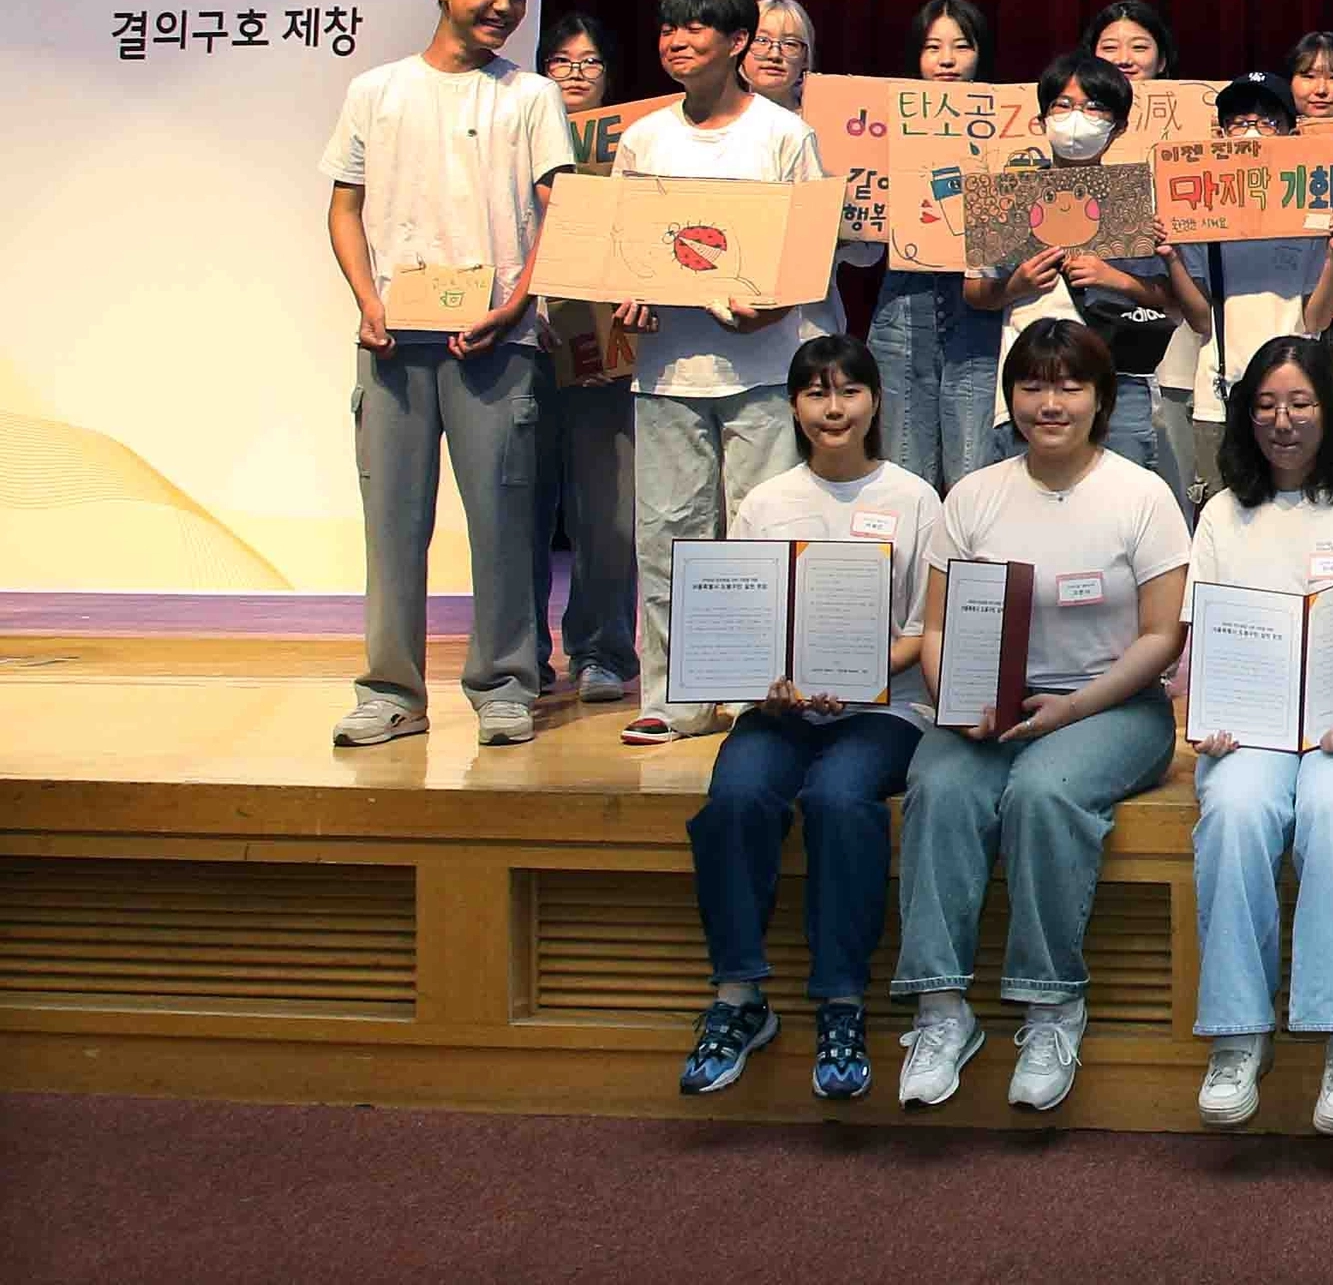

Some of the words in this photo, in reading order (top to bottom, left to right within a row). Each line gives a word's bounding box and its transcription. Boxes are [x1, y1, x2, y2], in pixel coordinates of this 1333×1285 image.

[111, 8, 270, 60] 결의구호
[281, 6, 364, 57] 제창
[1161, 144, 1203, 163] 이젠
[1211, 140, 1262, 160] 진짜
[1169, 166, 1271, 211] 마지막
